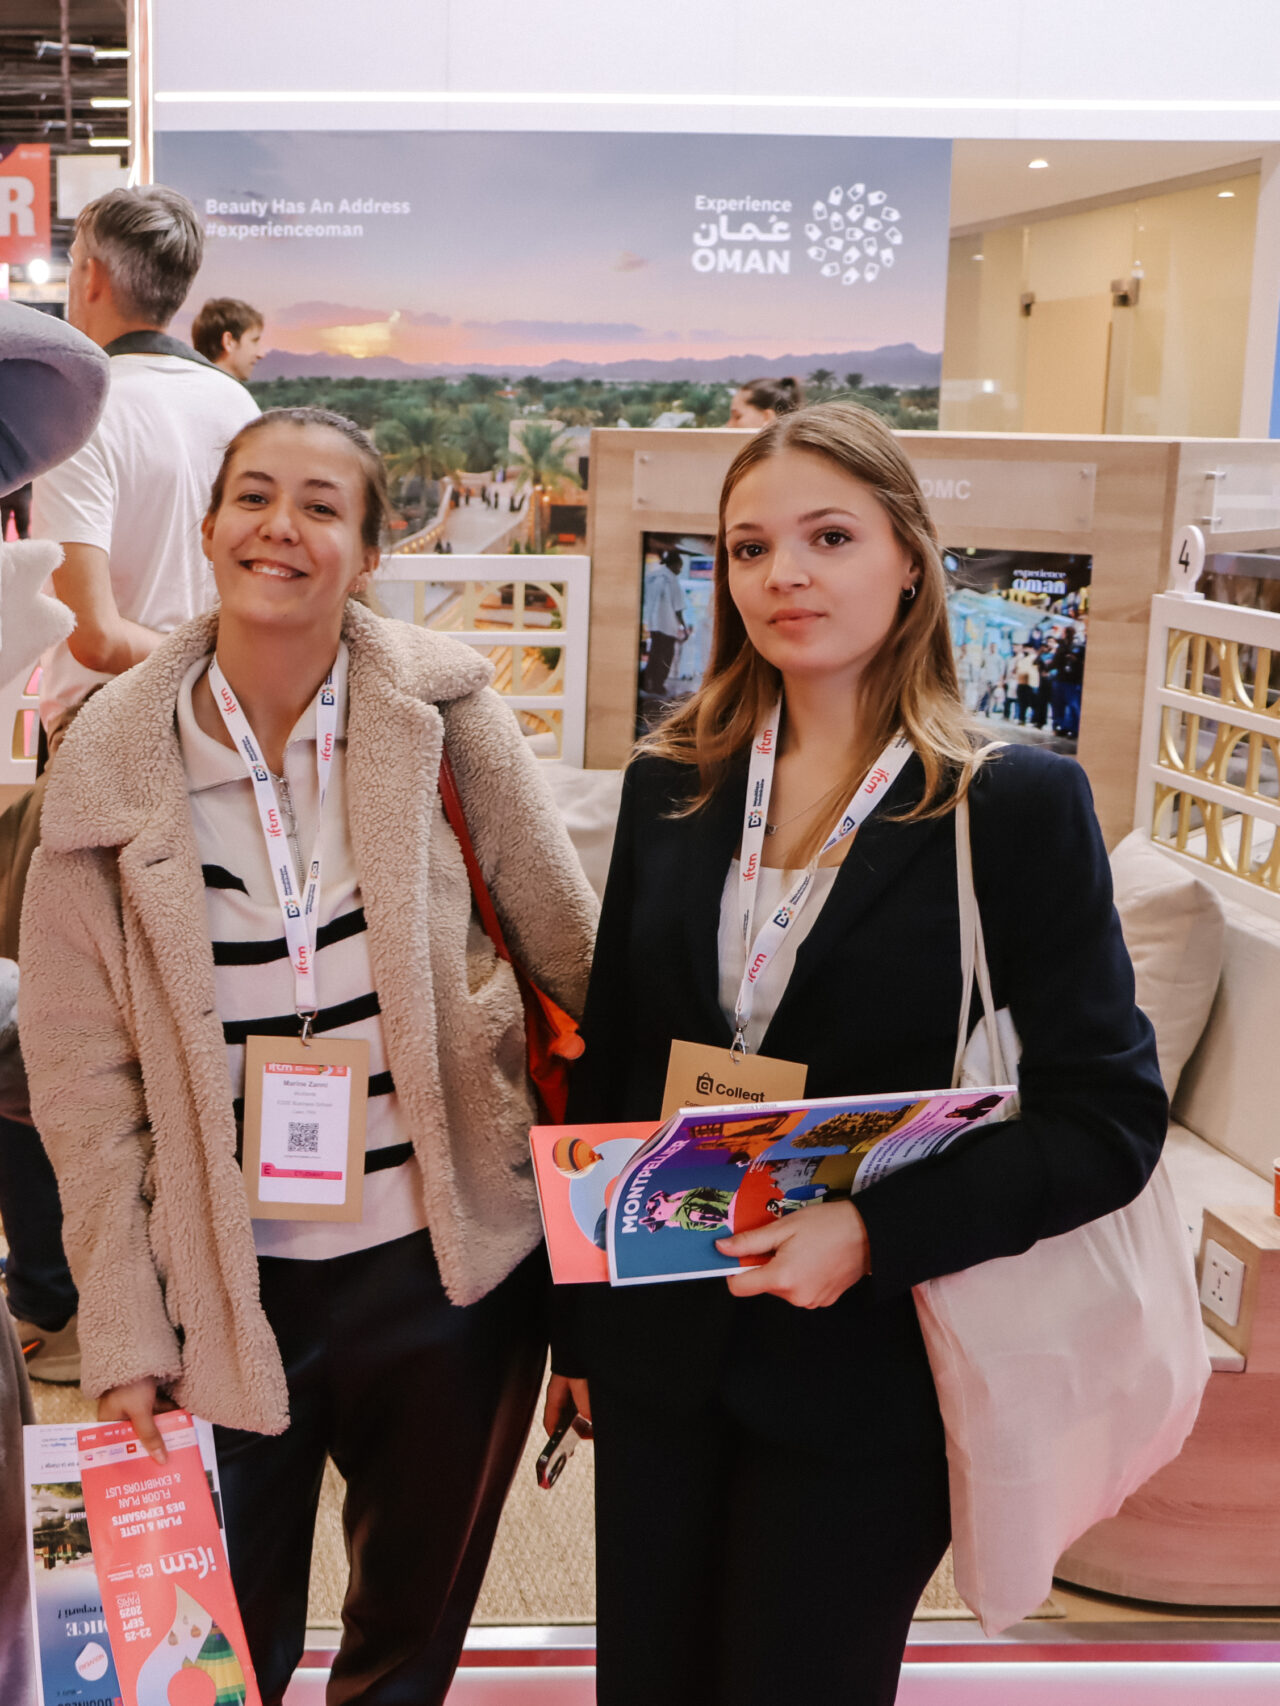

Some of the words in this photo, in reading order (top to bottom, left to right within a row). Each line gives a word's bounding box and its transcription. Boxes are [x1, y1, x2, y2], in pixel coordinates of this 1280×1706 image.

[205, 199, 269, 218] Beauty
[271, 199, 306, 215] Has
[310, 199, 335, 215] An
[338, 198, 411, 215] Address
[695, 195, 793, 214] Experience
[205, 221, 364, 240] #experienceoman
[691, 248, 790, 274] OMAN
[1178, 539, 1190, 574] 4
[1012, 578, 1066, 595] oman
[221, 687, 237, 715] iftm
[320, 732, 333, 761] iftm
[756, 729, 773, 755] iftm
[864, 768, 890, 794] iftm
[266, 808, 282, 838] iftm
[742, 853, 758, 882] iftm
[295, 945, 309, 975] iftm
[747, 953, 767, 984] iftm
[716, 1083, 765, 1103] Colleqt
[622, 1139, 691, 1234] MONTPELLIER
[123, 1475, 173, 1494] EXHIBITORS
[174, 1472, 182, 1483] &
[106, 1485, 122, 1499] LIST
[119, 1495, 141, 1508] PLAN
[142, 1488, 171, 1502] FLOOR
[167, 1500, 186, 1511] DES
[111, 1506, 165, 1526] EXPOSANTS
[147, 1520, 155, 1531] &
[157, 1514, 183, 1531] PLAN
[120, 1523, 145, 1538] LISTE
[160, 1546, 217, 1579] iftm
[116, 1595, 141, 1609] PARIS
[120, 1605, 142, 1619] 2025
[122, 1616, 145, 1631] SEPT
[124, 1627, 152, 1642] 23-25
